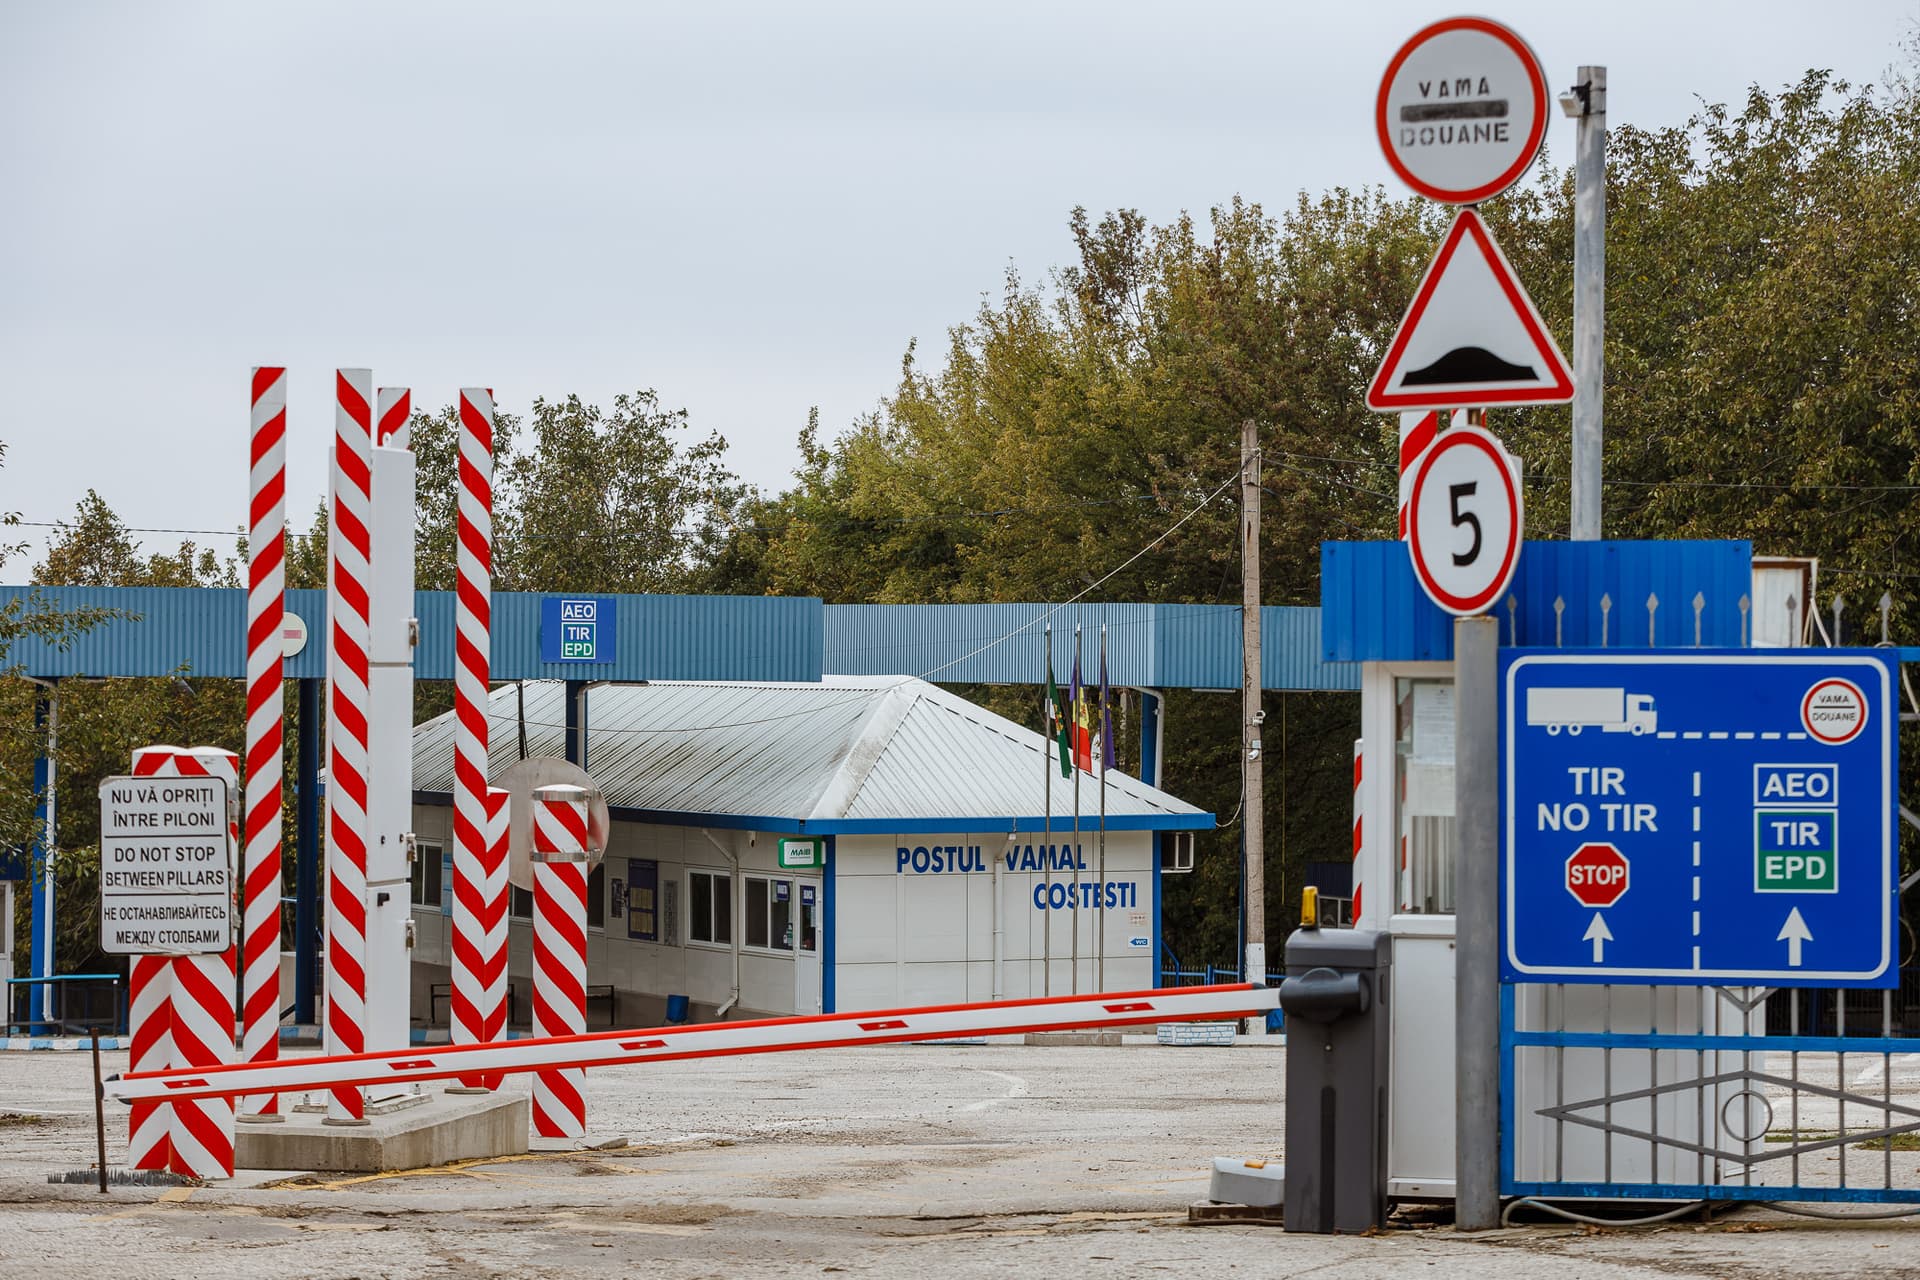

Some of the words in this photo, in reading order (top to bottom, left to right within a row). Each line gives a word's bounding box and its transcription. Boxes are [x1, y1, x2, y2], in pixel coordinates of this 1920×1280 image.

[1418, 76, 1490, 98] VAMA
[1400, 123, 1509, 148] DOUANE
[1449, 481, 1482, 567] 5
[564, 605, 593, 618] AEO
[568, 627, 590, 640] TIR
[565, 643, 592, 656] EPD
[1819, 695, 1849, 704] VAMA
[1812, 712, 1856, 721] DOUANE
[1568, 767, 1626, 796] TIR
[1763, 773, 1829, 797] AEO
[111, 789, 132, 804] NU
[137, 786, 158, 803] VĂ
[162, 788, 214, 808] OPRIȚI
[113, 810, 158, 827] ÎNTRE
[164, 812, 215, 827] PILONI
[1537, 803, 1589, 832] NO
[1600, 803, 1658, 832] TIR
[1771, 821, 1820, 846] TIR
[115, 847, 135, 862] DO
[140, 847, 170, 862] NOT
[175, 846, 215, 861] STOP
[897, 846, 986, 873] POSTUL
[1005, 844, 1086, 871] VAMAL
[106, 871, 164, 887] BETWEEN
[167, 870, 224, 886] PILLARS
[1570, 864, 1625, 885] STOP
[1765, 856, 1826, 880] EPD
[104, 906, 117, 921] НЕ
[119, 904, 226, 921] ОСТАНАВЛИВАЙТЕСЬ
[116, 930, 155, 946] МЕЖДУ
[159, 929, 220, 944] СТОЛБАМИ
